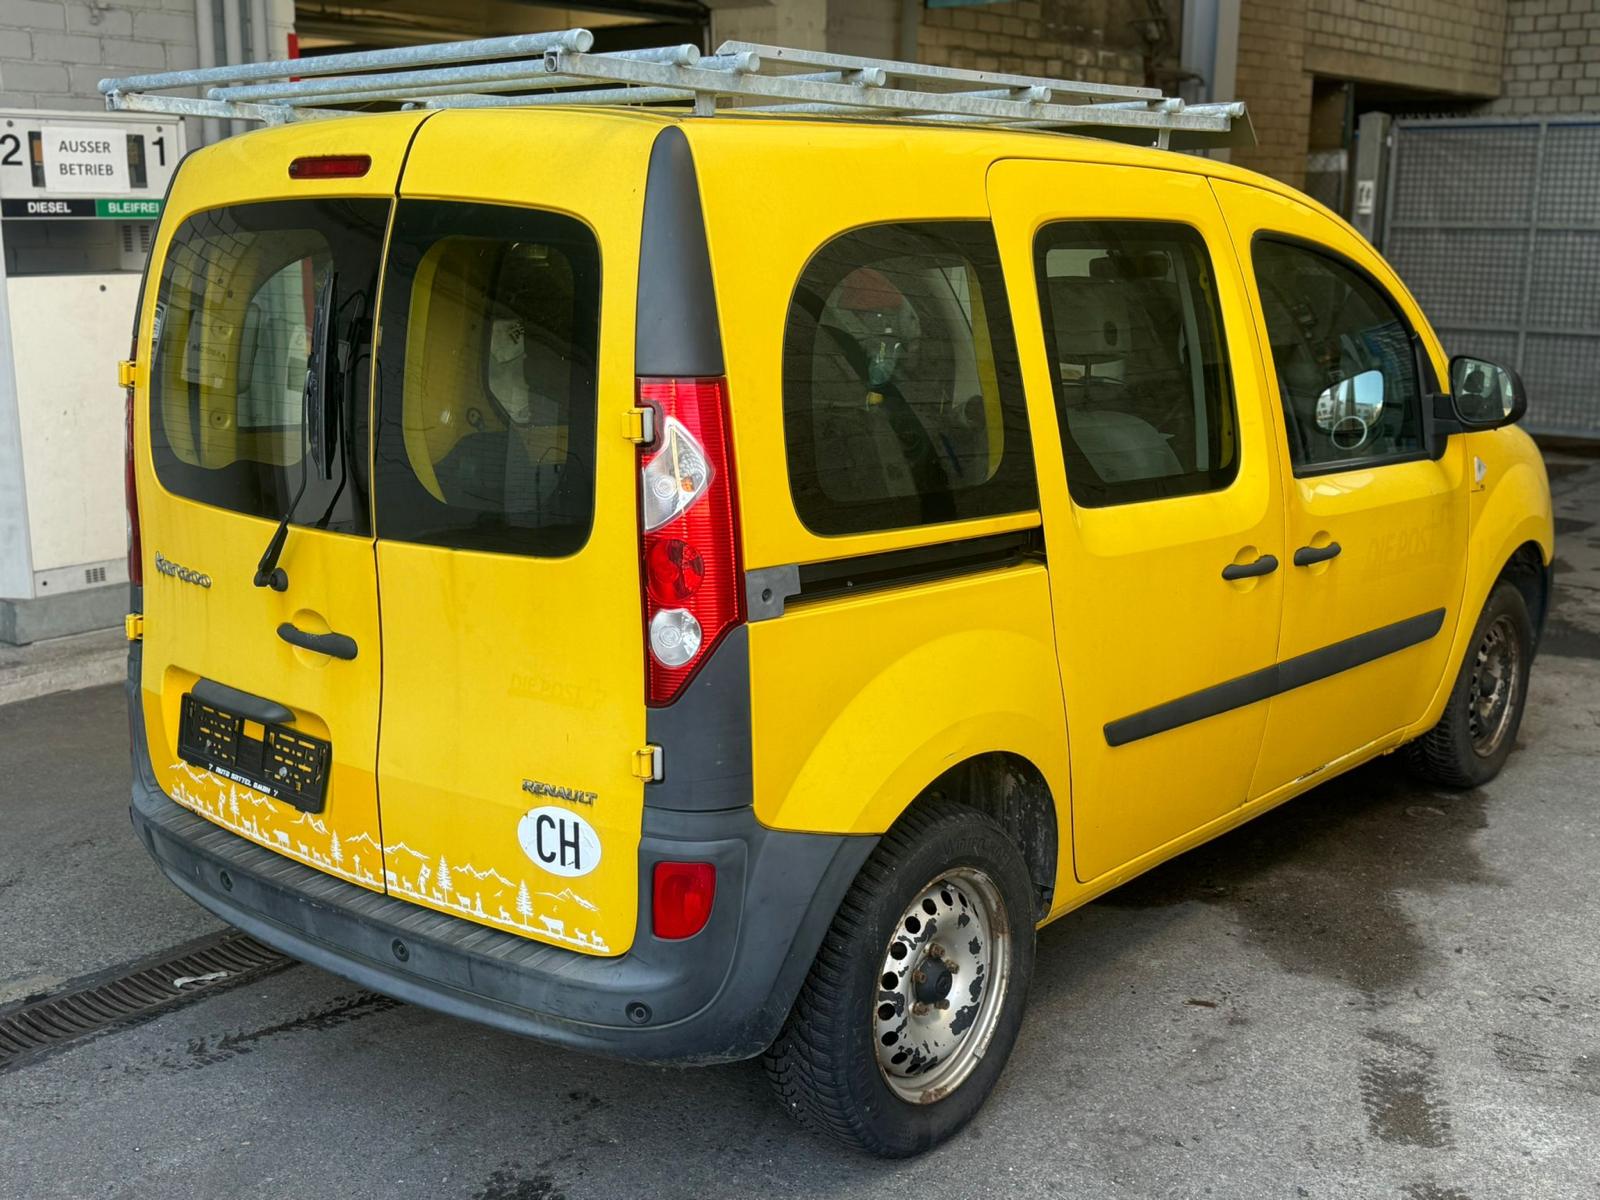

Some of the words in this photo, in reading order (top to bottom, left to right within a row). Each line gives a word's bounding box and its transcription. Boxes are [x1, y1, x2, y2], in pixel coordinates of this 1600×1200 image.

[0, 134, 23, 166] 2
[59, 140, 111, 154] AUSSER
[152, 136, 166, 166] 1
[59, 163, 114, 176] BETRIEB
[27, 202, 72, 214] DIESEL
[108, 202, 160, 214] BLEIFREI
[522, 778, 598, 806] RENAULT
[536, 814, 581, 870] CH
